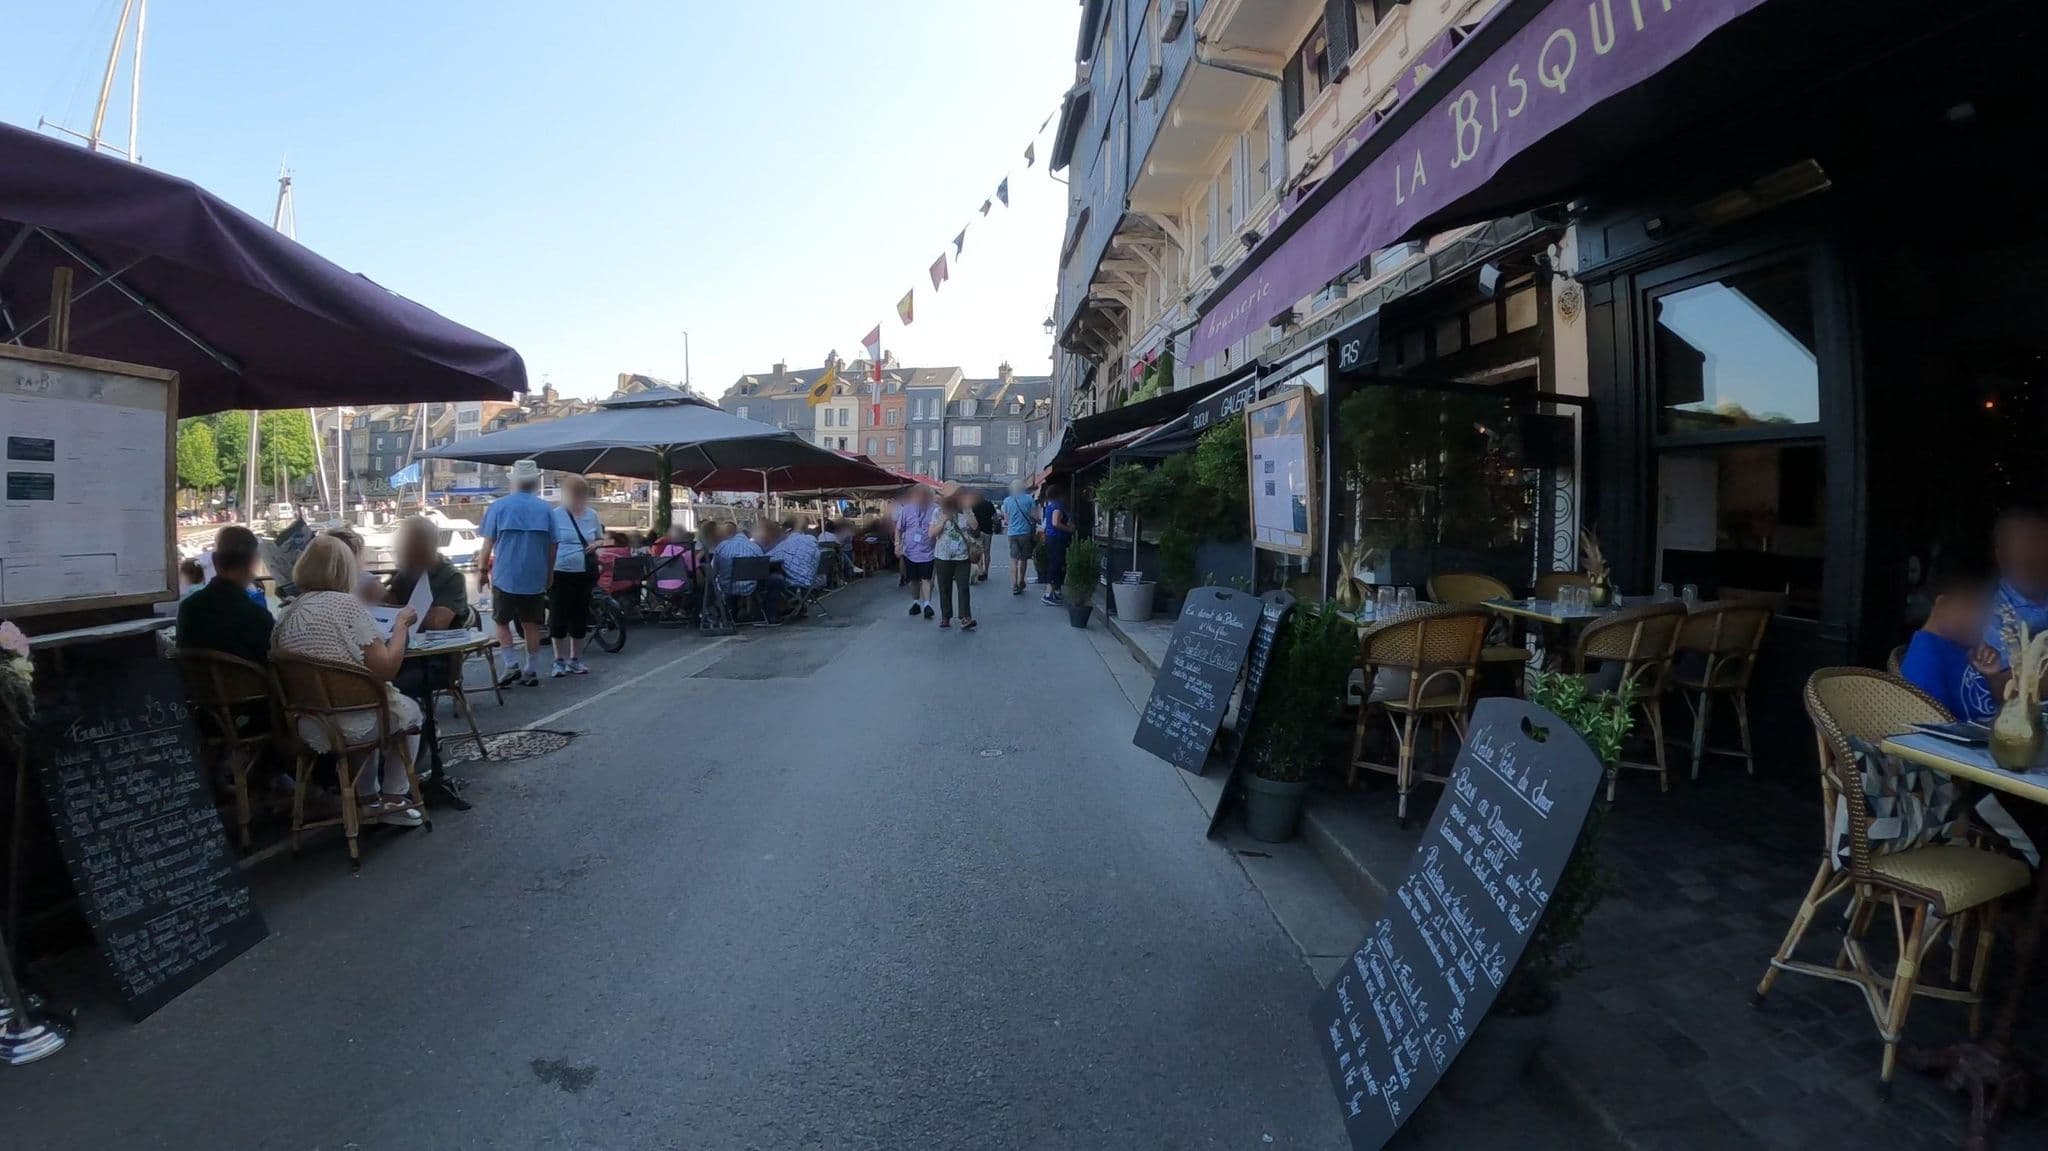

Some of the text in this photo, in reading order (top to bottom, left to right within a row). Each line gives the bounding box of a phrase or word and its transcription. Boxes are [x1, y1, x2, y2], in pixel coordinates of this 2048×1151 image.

[1395, 0, 1672, 206] LA BISQUI
[1208, 276, 1270, 338] brasserie
[1220, 385, 1255, 417] GALERIE
